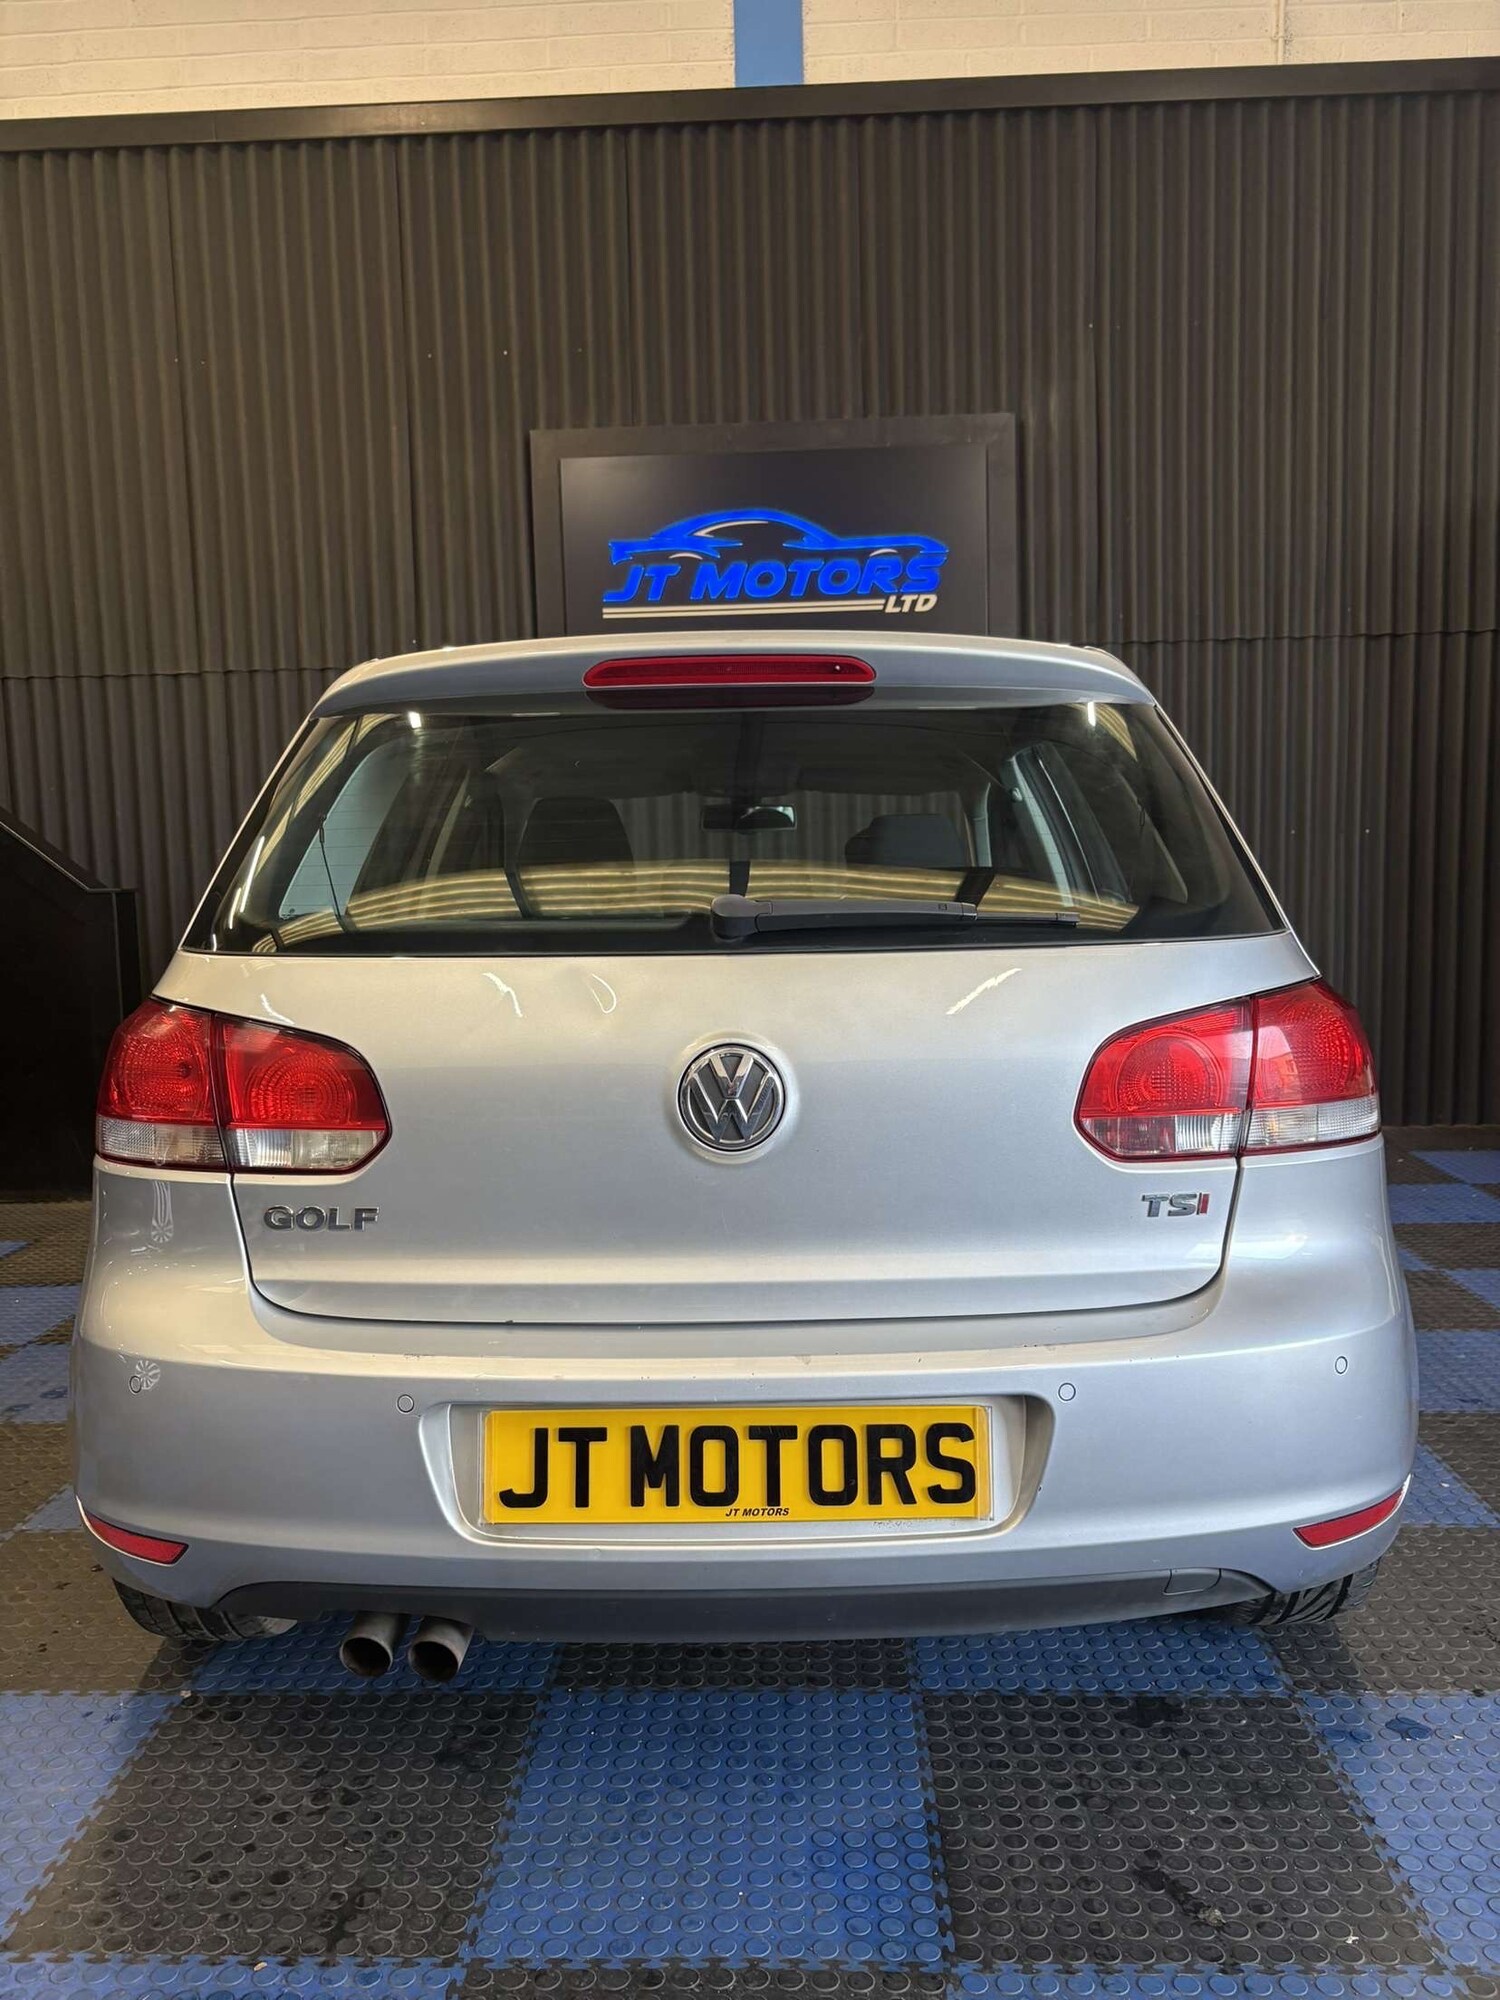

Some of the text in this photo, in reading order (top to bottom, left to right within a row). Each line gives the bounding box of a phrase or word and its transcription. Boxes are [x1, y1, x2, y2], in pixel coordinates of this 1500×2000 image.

[602, 556, 947, 603] JT MOTORS
[884, 593, 937, 613] LTD
[264, 1205, 379, 1230] GOLF
[1141, 1192, 1211, 1218] TSI
[498, 1422, 976, 1509] JT MOTORS
[725, 1508, 789, 1517] JT MOTORS
